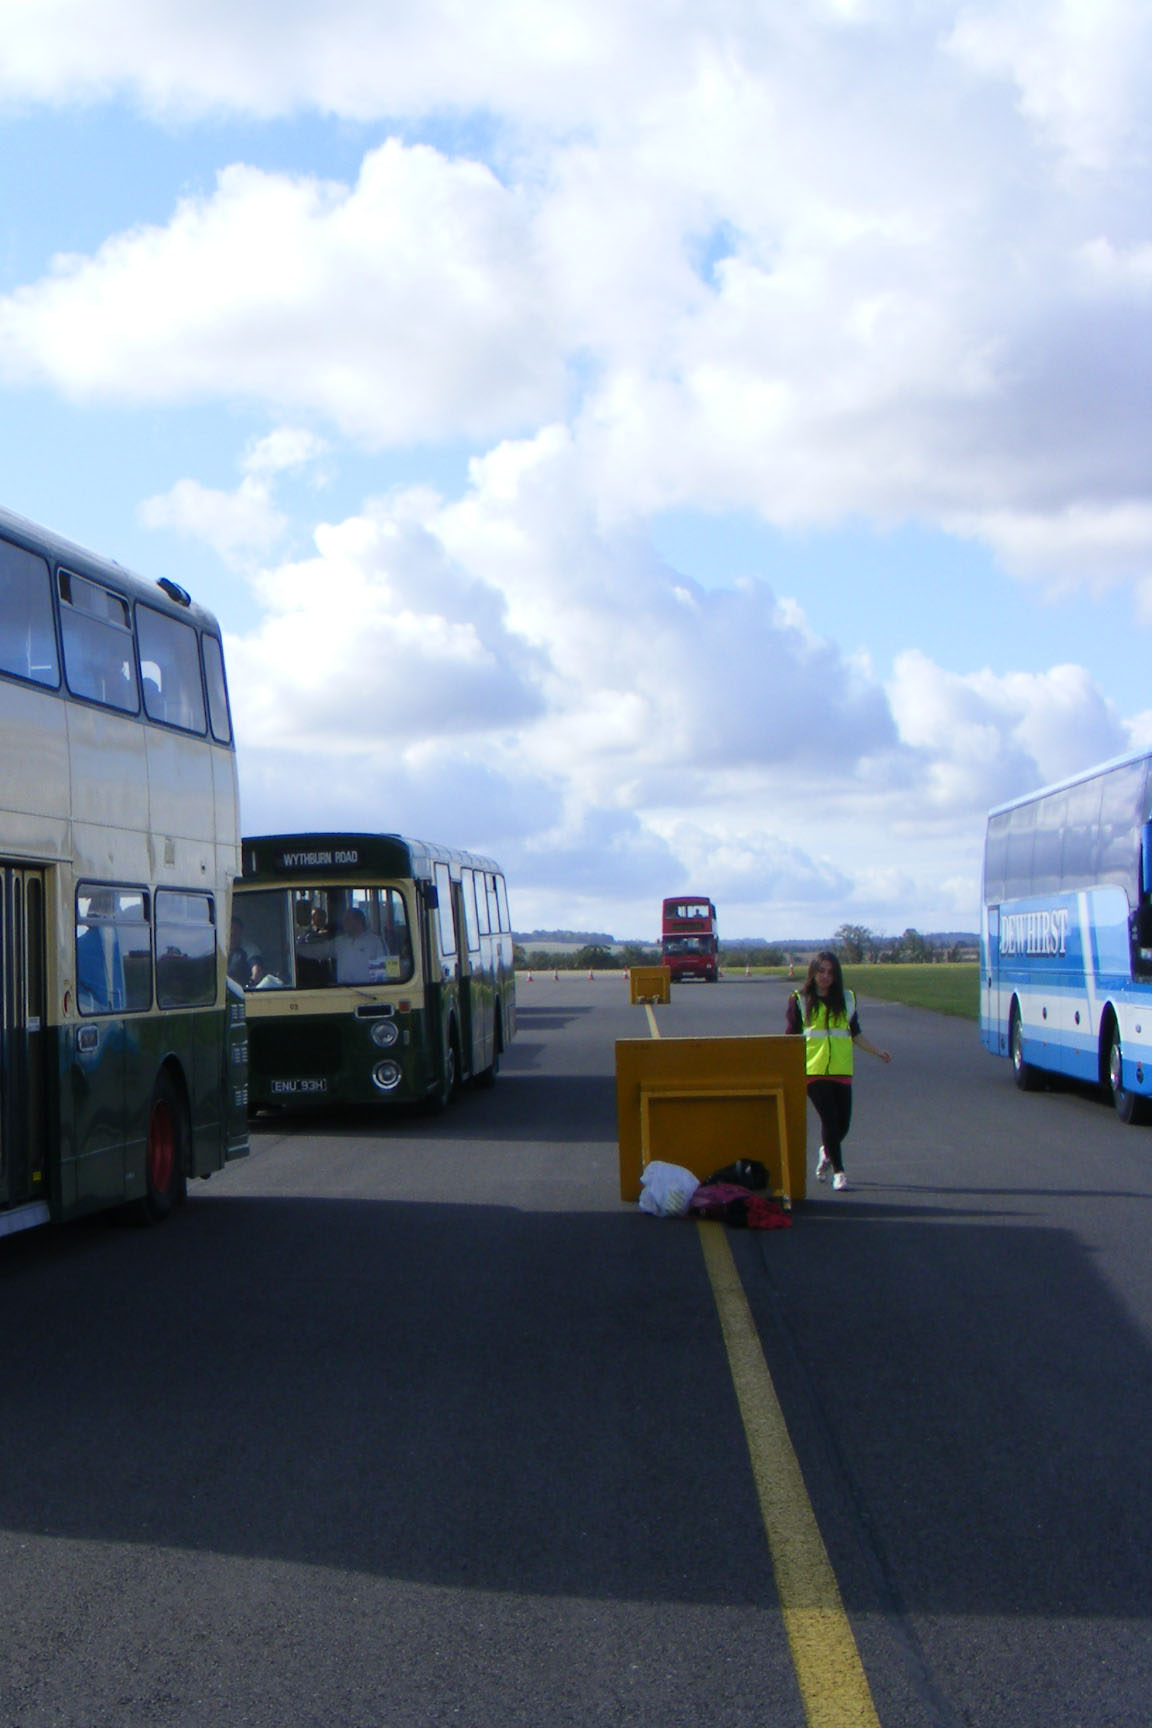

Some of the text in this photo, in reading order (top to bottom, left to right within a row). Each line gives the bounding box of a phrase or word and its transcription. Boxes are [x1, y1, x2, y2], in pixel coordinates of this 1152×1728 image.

[283, 850, 358, 867] WYTHBURN ROAD
[1000, 908, 1068, 956] DEWHIRST
[274, 1079, 324, 1092] ENU 93H
